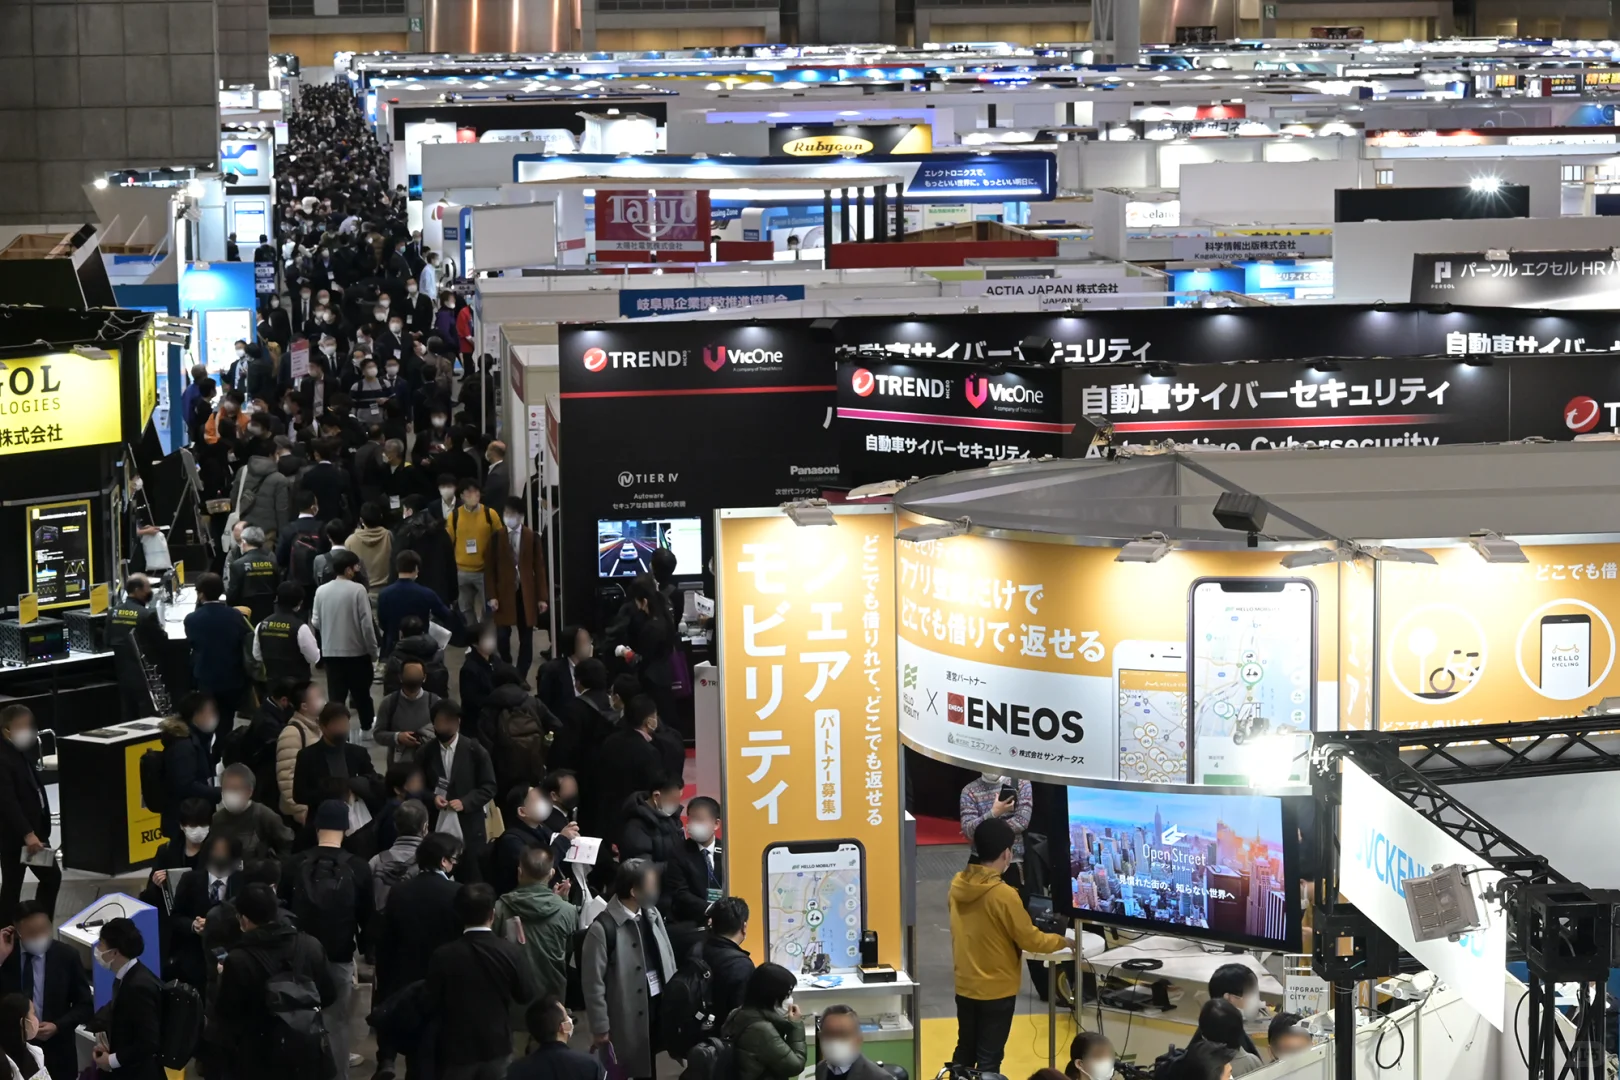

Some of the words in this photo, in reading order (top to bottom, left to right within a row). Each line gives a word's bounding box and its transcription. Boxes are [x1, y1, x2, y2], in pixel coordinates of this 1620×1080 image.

[793, 141, 863, 154] Rubycon
[924, 169, 987, 177] エレクトロニクスで、
[924, 178, 1038, 188] もっといい世界に。もっといい明日に。
[606, 195, 697, 238] Taiyo
[1204, 240, 1296, 251] 科学情報出版株式会社
[1460, 261, 1518, 278] パーソル
[1521, 261, 1578, 276] エクセル
[986, 285, 1025, 296] ACTIA
[1027, 284, 1073, 295] JAPAN
[1076, 283, 1119, 294] 株式会社
[608, 350, 681, 369] TREND
[727, 348, 784, 365] VicOne
[0, 365, 61, 396] OL
[875, 374, 945, 399] TREND
[988, 383, 1044, 404] VicOne
[1082, 378, 1450, 416] 自動車サイバーセキュリティ
[0, 423, 63, 448] 株式会社
[865, 433, 1031, 461] 自動車サイバーセキュリティ
[635, 473, 665, 483] TIER
[668, 472, 679, 483] IV
[612, 500, 686, 510] セキュアな自動運転の実現
[118, 609, 139, 617] RIGOL
[268, 621, 291, 629] RIGOL
[901, 595, 1106, 663] どこでも借りて・返せる
[737, 543, 792, 825] モビリティ
[862, 534, 883, 826] どこでも借りれて、どこでも返せる
[945, 670, 987, 686] 運営パートナー
[948, 704, 964, 713] ENEOS
[967, 696, 1085, 744] ENEOS
[820, 714, 836, 815] パートナー募集
[1019, 749, 1085, 765] 株式会社サンオータス
